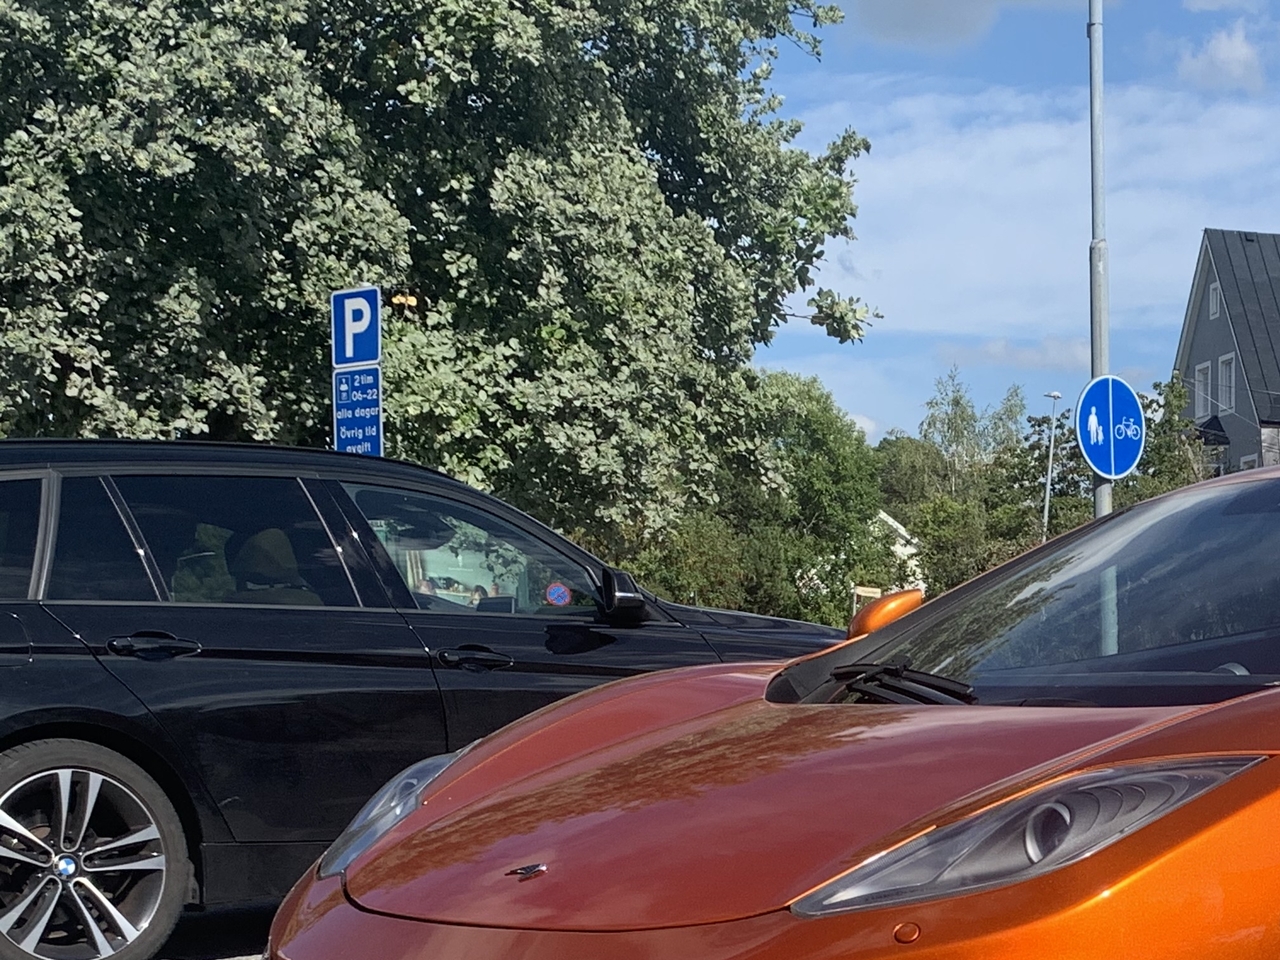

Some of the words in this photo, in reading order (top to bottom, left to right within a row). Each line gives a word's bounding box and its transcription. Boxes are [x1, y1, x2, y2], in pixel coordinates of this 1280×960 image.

[344, 297, 372, 358] P
[353, 375, 360, 386] 2
[361, 374, 374, 384] tim
[336, 408, 353, 419] alla
[354, 405, 379, 418] dagar
[365, 425, 377, 436] tid
